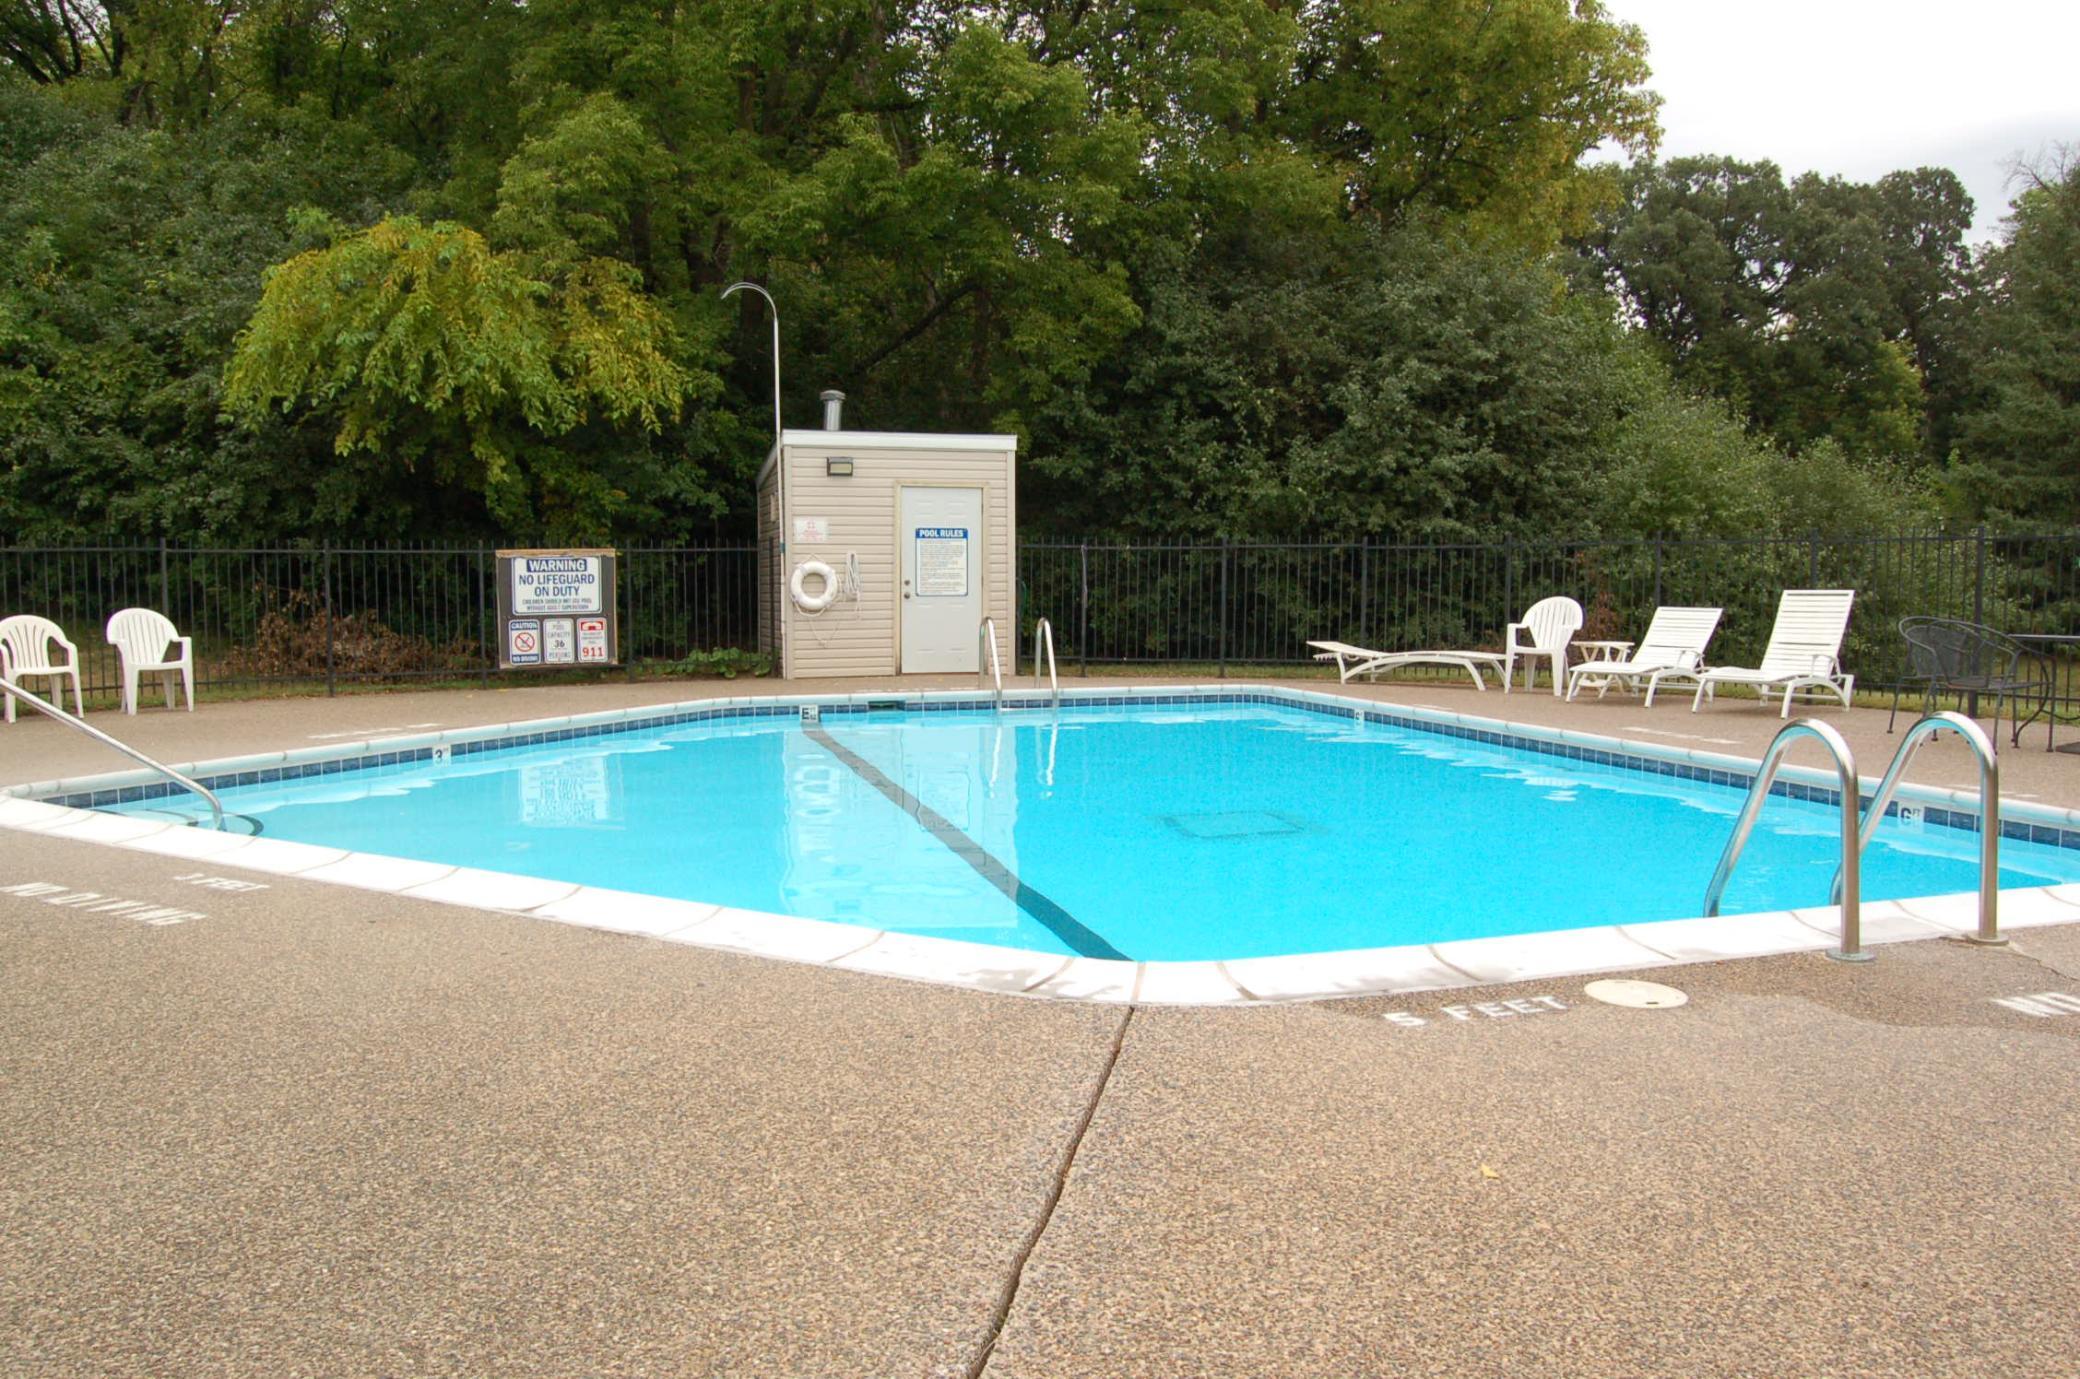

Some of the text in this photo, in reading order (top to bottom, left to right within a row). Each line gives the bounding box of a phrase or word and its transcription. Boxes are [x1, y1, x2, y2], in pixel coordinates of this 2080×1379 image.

[919, 529, 964, 537] POOL RULES
[529, 559, 586, 571] WARNING
[519, 574, 595, 585] NO LIFEGUARD
[534, 585, 580, 597] ON DUTY
[554, 639, 566, 648] 36
[582, 646, 603, 657] 911
[190, 876, 272, 892] FEET
[0, 881, 208, 926] NO DIVING
[1382, 995, 1569, 1027] 5 FEET
